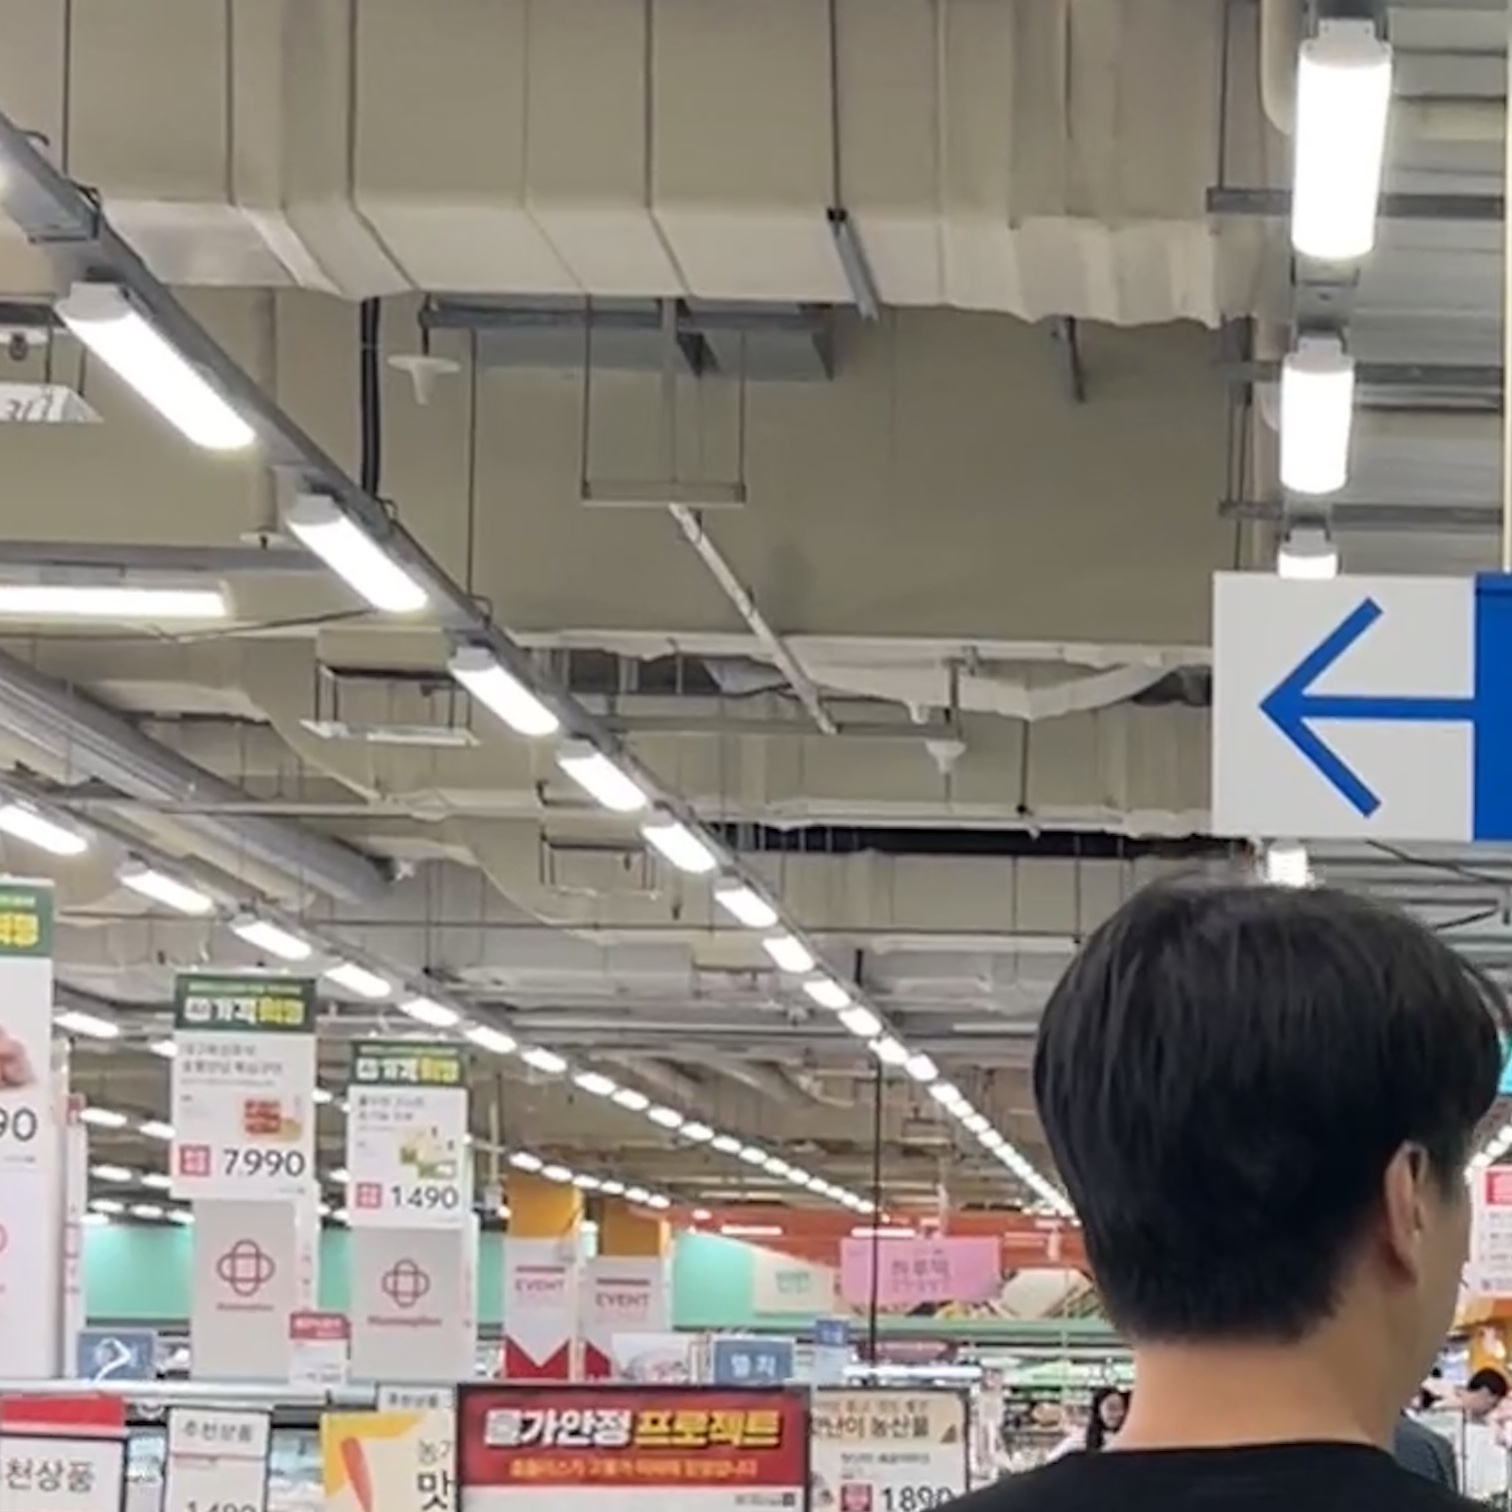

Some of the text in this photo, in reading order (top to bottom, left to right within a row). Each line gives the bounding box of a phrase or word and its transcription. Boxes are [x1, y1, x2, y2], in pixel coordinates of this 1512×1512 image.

[515, 1278, 565, 1292] EVENT
[596, 1293, 650, 1308] EVENT
[484, 1408, 781, 1448] 물가안정 프로젝트
[3, 1458, 96, 1494] 천상품
